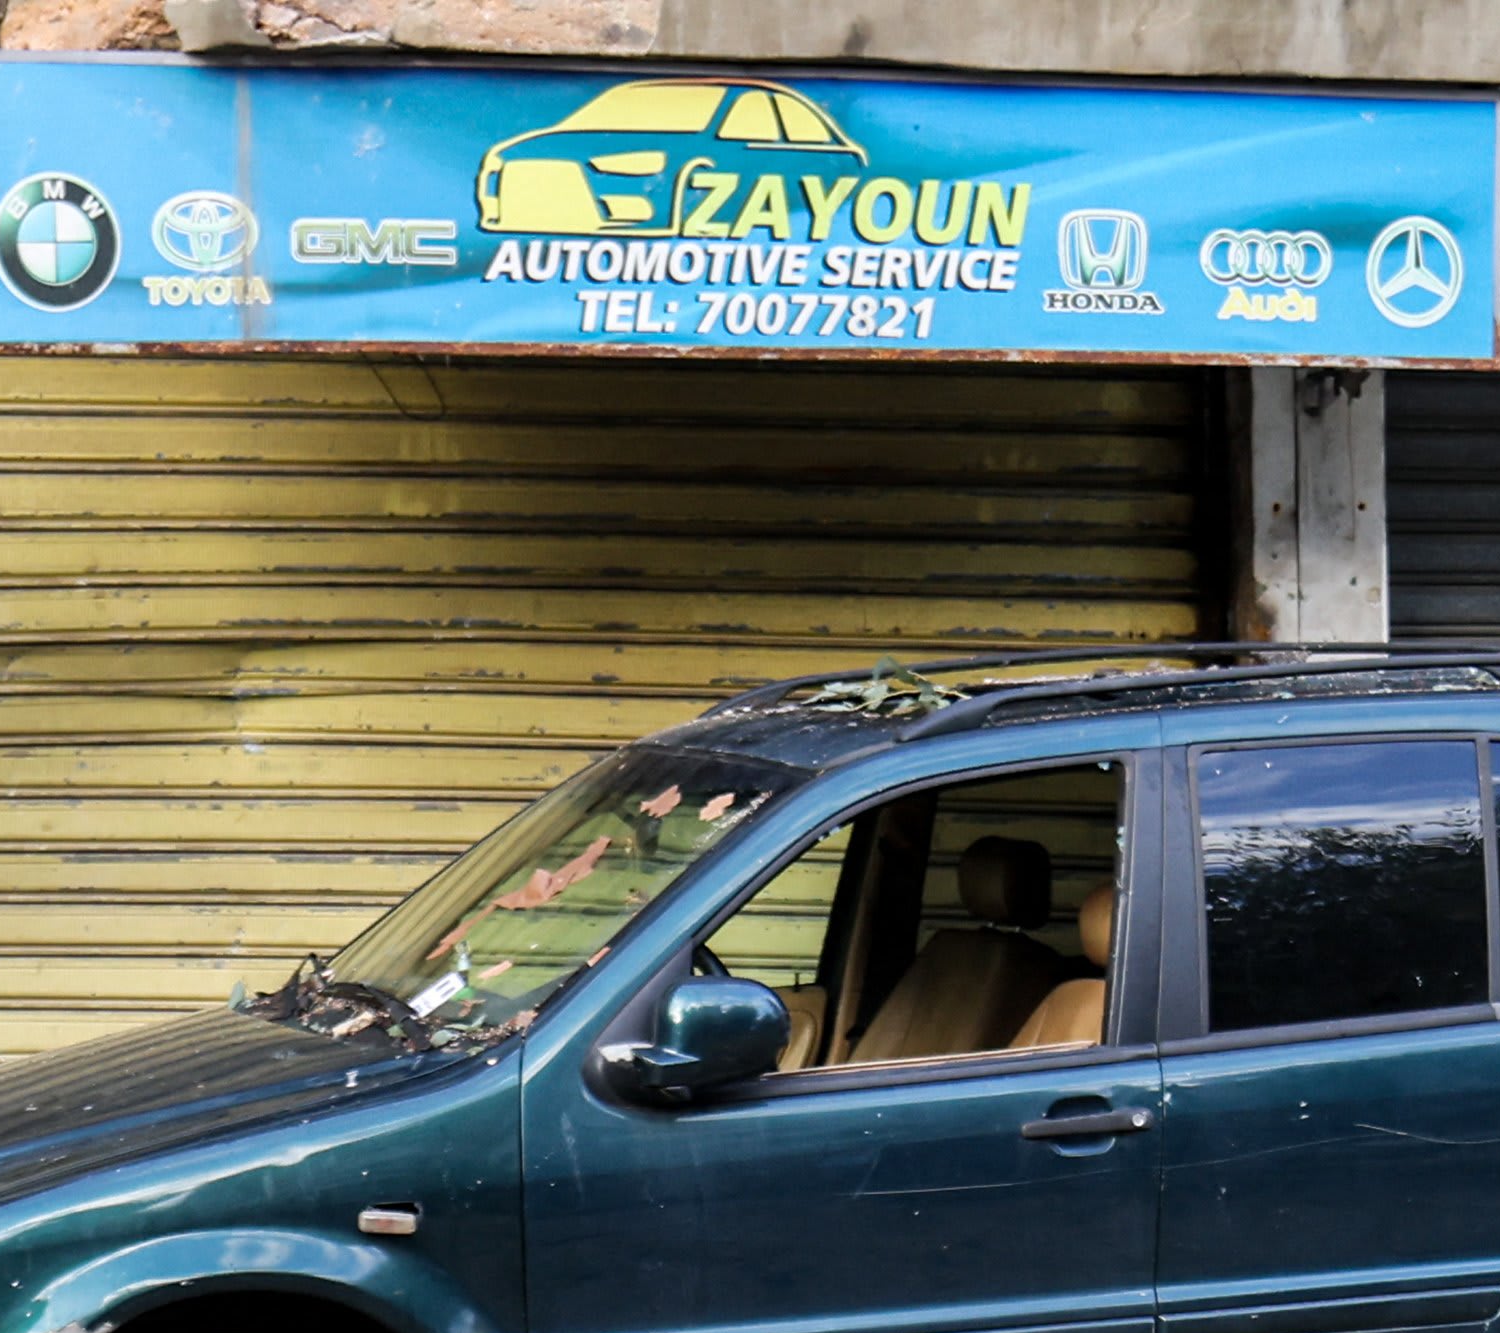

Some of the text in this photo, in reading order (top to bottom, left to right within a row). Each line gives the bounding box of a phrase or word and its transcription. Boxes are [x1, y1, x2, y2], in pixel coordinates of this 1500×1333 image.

[8, 179, 105, 221] BMW
[682, 172, 1032, 247] ZAYOUN
[292, 218, 456, 265] GMC
[484, 240, 1022, 291] AUTOMOTIVE SERVICE
[144, 277, 271, 306] TOYOTA
[1045, 291, 1163, 314] HONDA
[1218, 288, 1318, 321] Audi
[578, 291, 937, 339] TEL: 70077821
